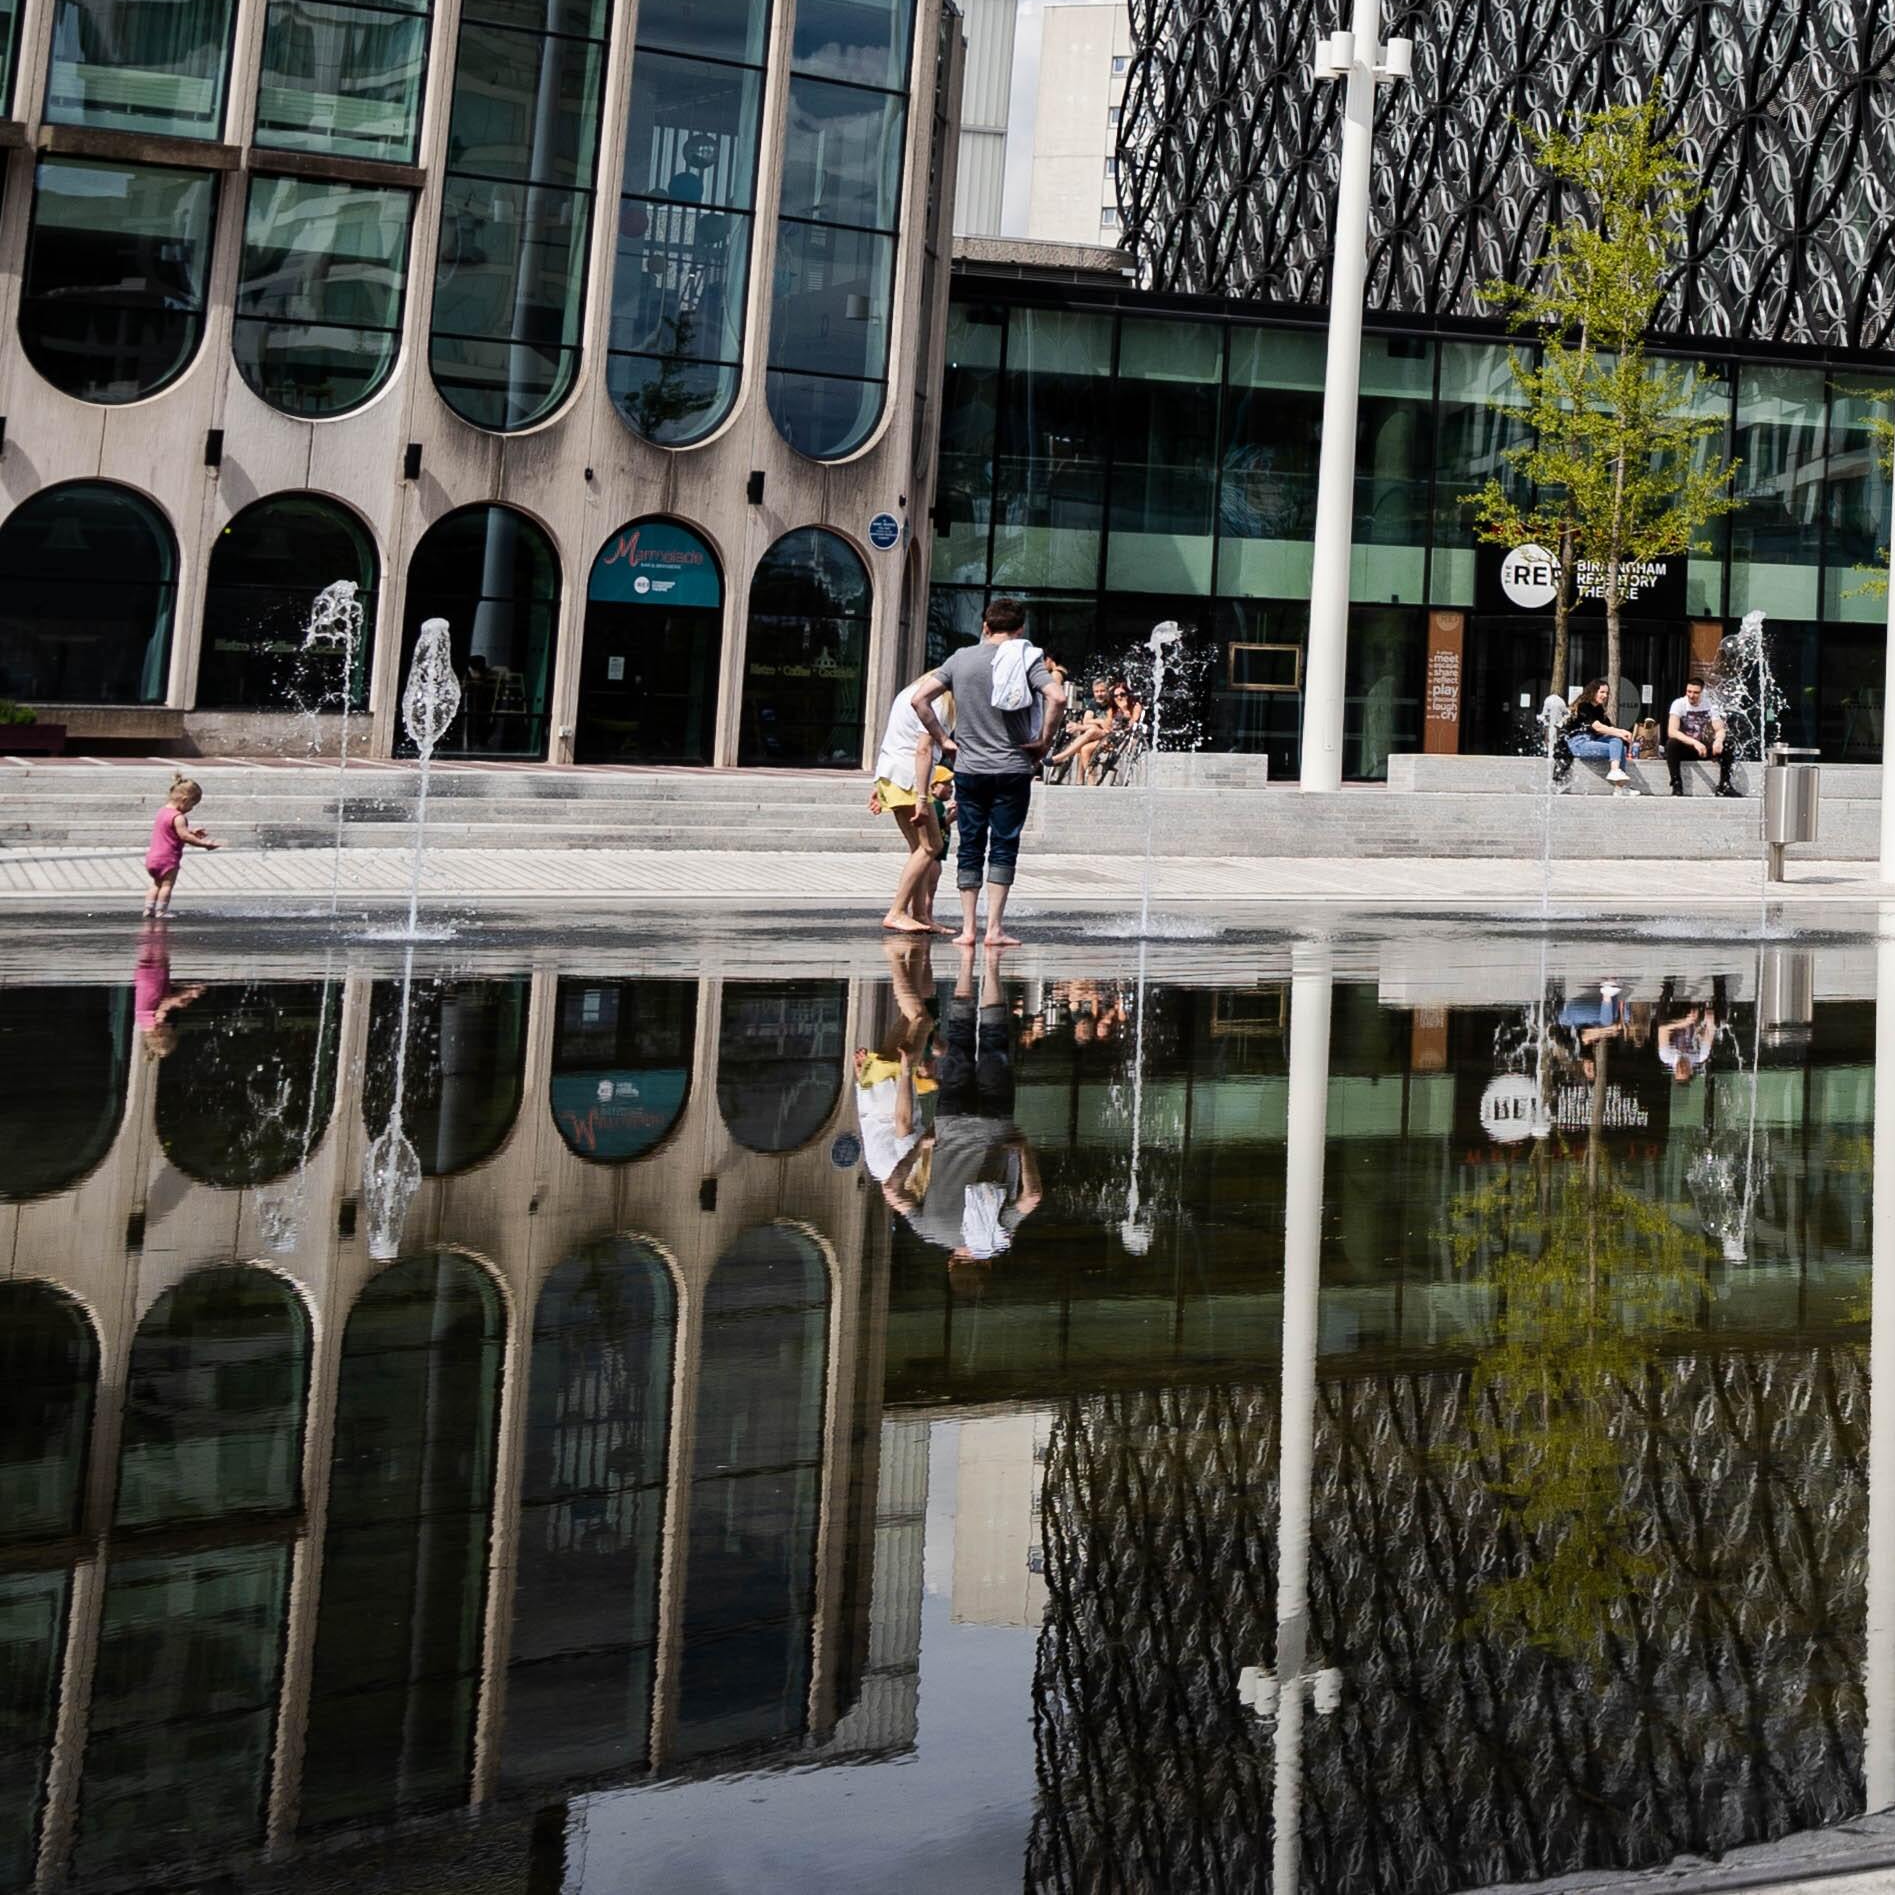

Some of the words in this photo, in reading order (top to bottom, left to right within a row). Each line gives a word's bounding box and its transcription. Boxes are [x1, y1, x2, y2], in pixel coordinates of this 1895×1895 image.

[1577, 560, 1666, 575] BIRNGHAM
[1577, 573, 1657, 588] REPTORY
[1576, 585, 1639, 600] THETE
[1432, 683, 1459, 698] play
[1440, 710, 1457, 722] cry
